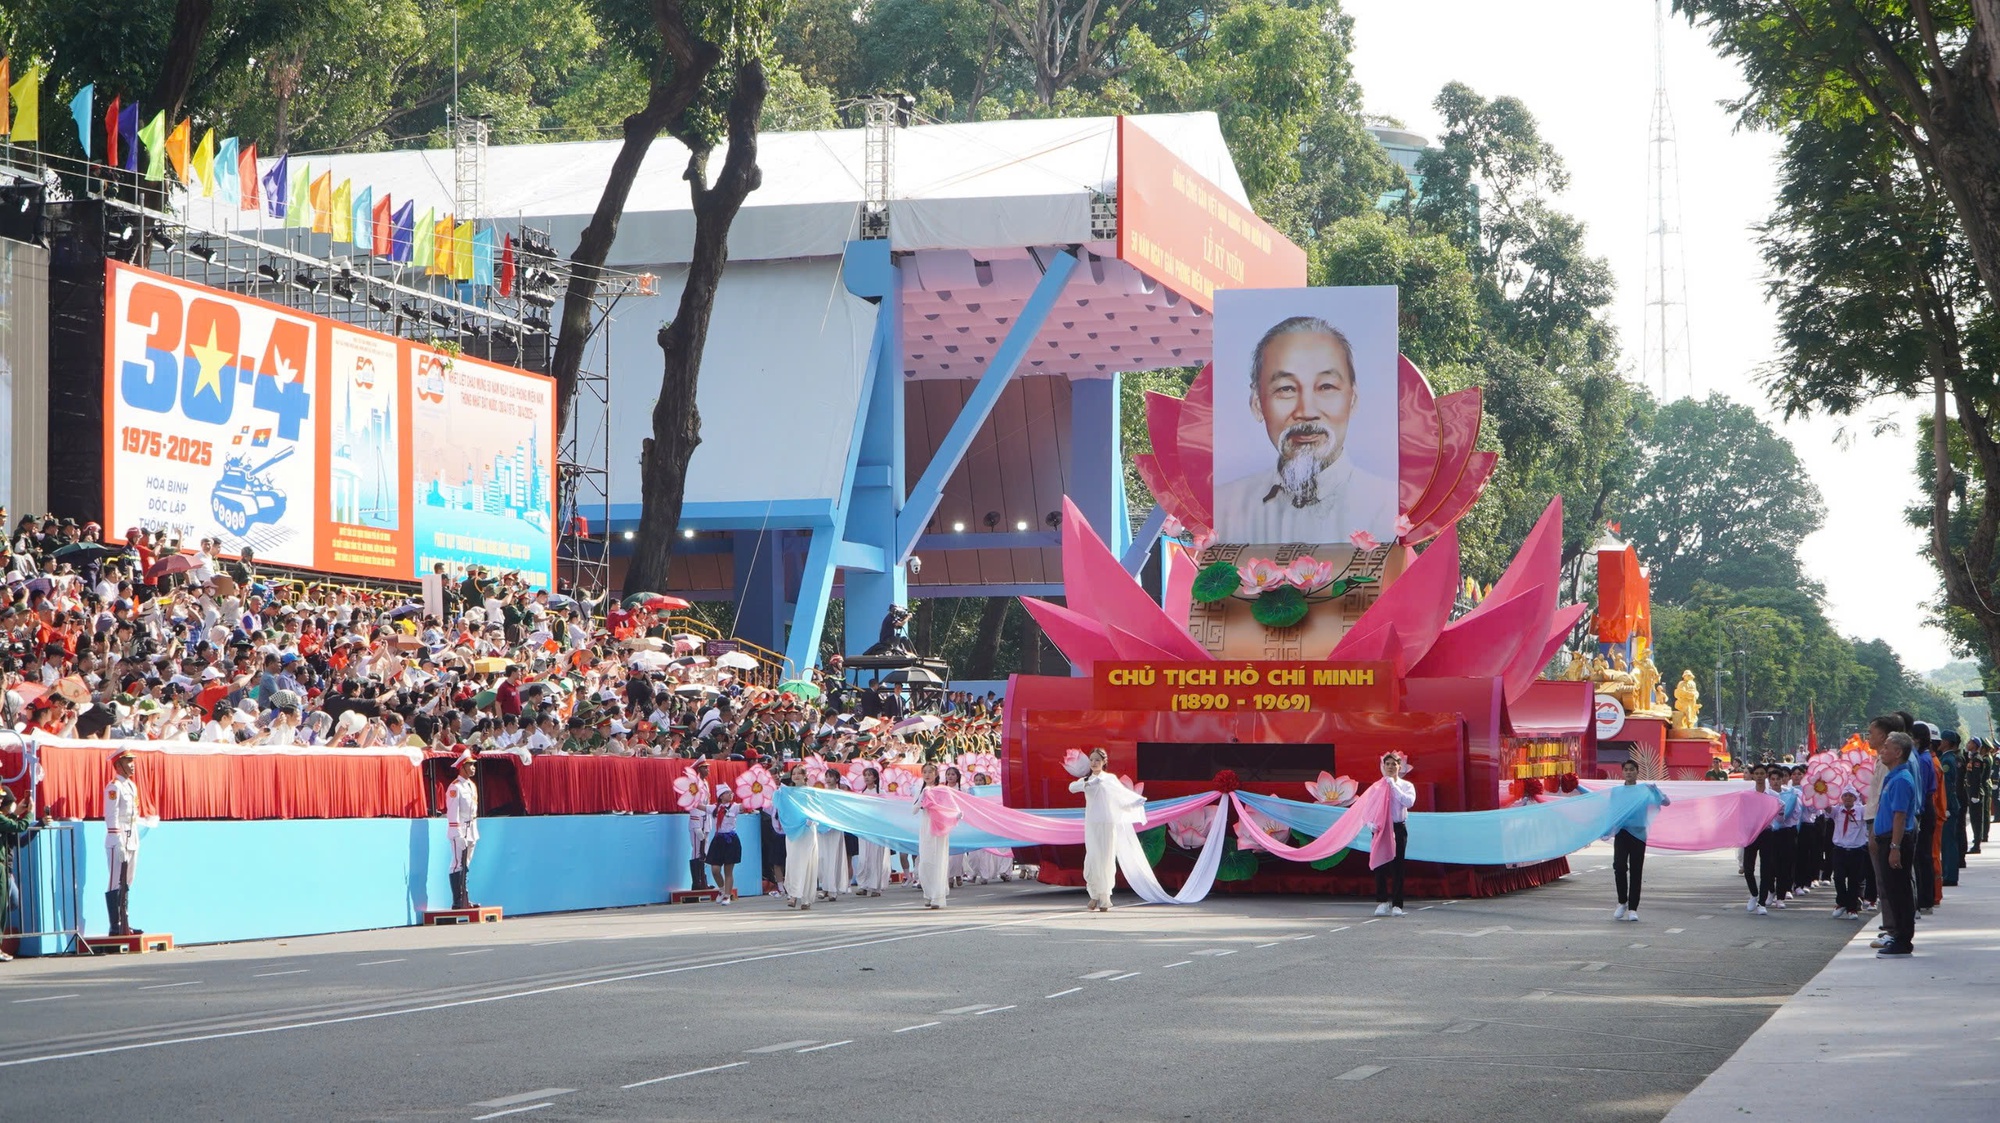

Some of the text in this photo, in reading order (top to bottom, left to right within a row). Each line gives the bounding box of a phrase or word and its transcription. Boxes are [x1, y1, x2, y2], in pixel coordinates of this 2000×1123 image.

[1108, 663, 1375, 689] CHỦ TỊCH HỒ CHÍ MINH
[1171, 693, 1311, 712] (1890 - 1969)
